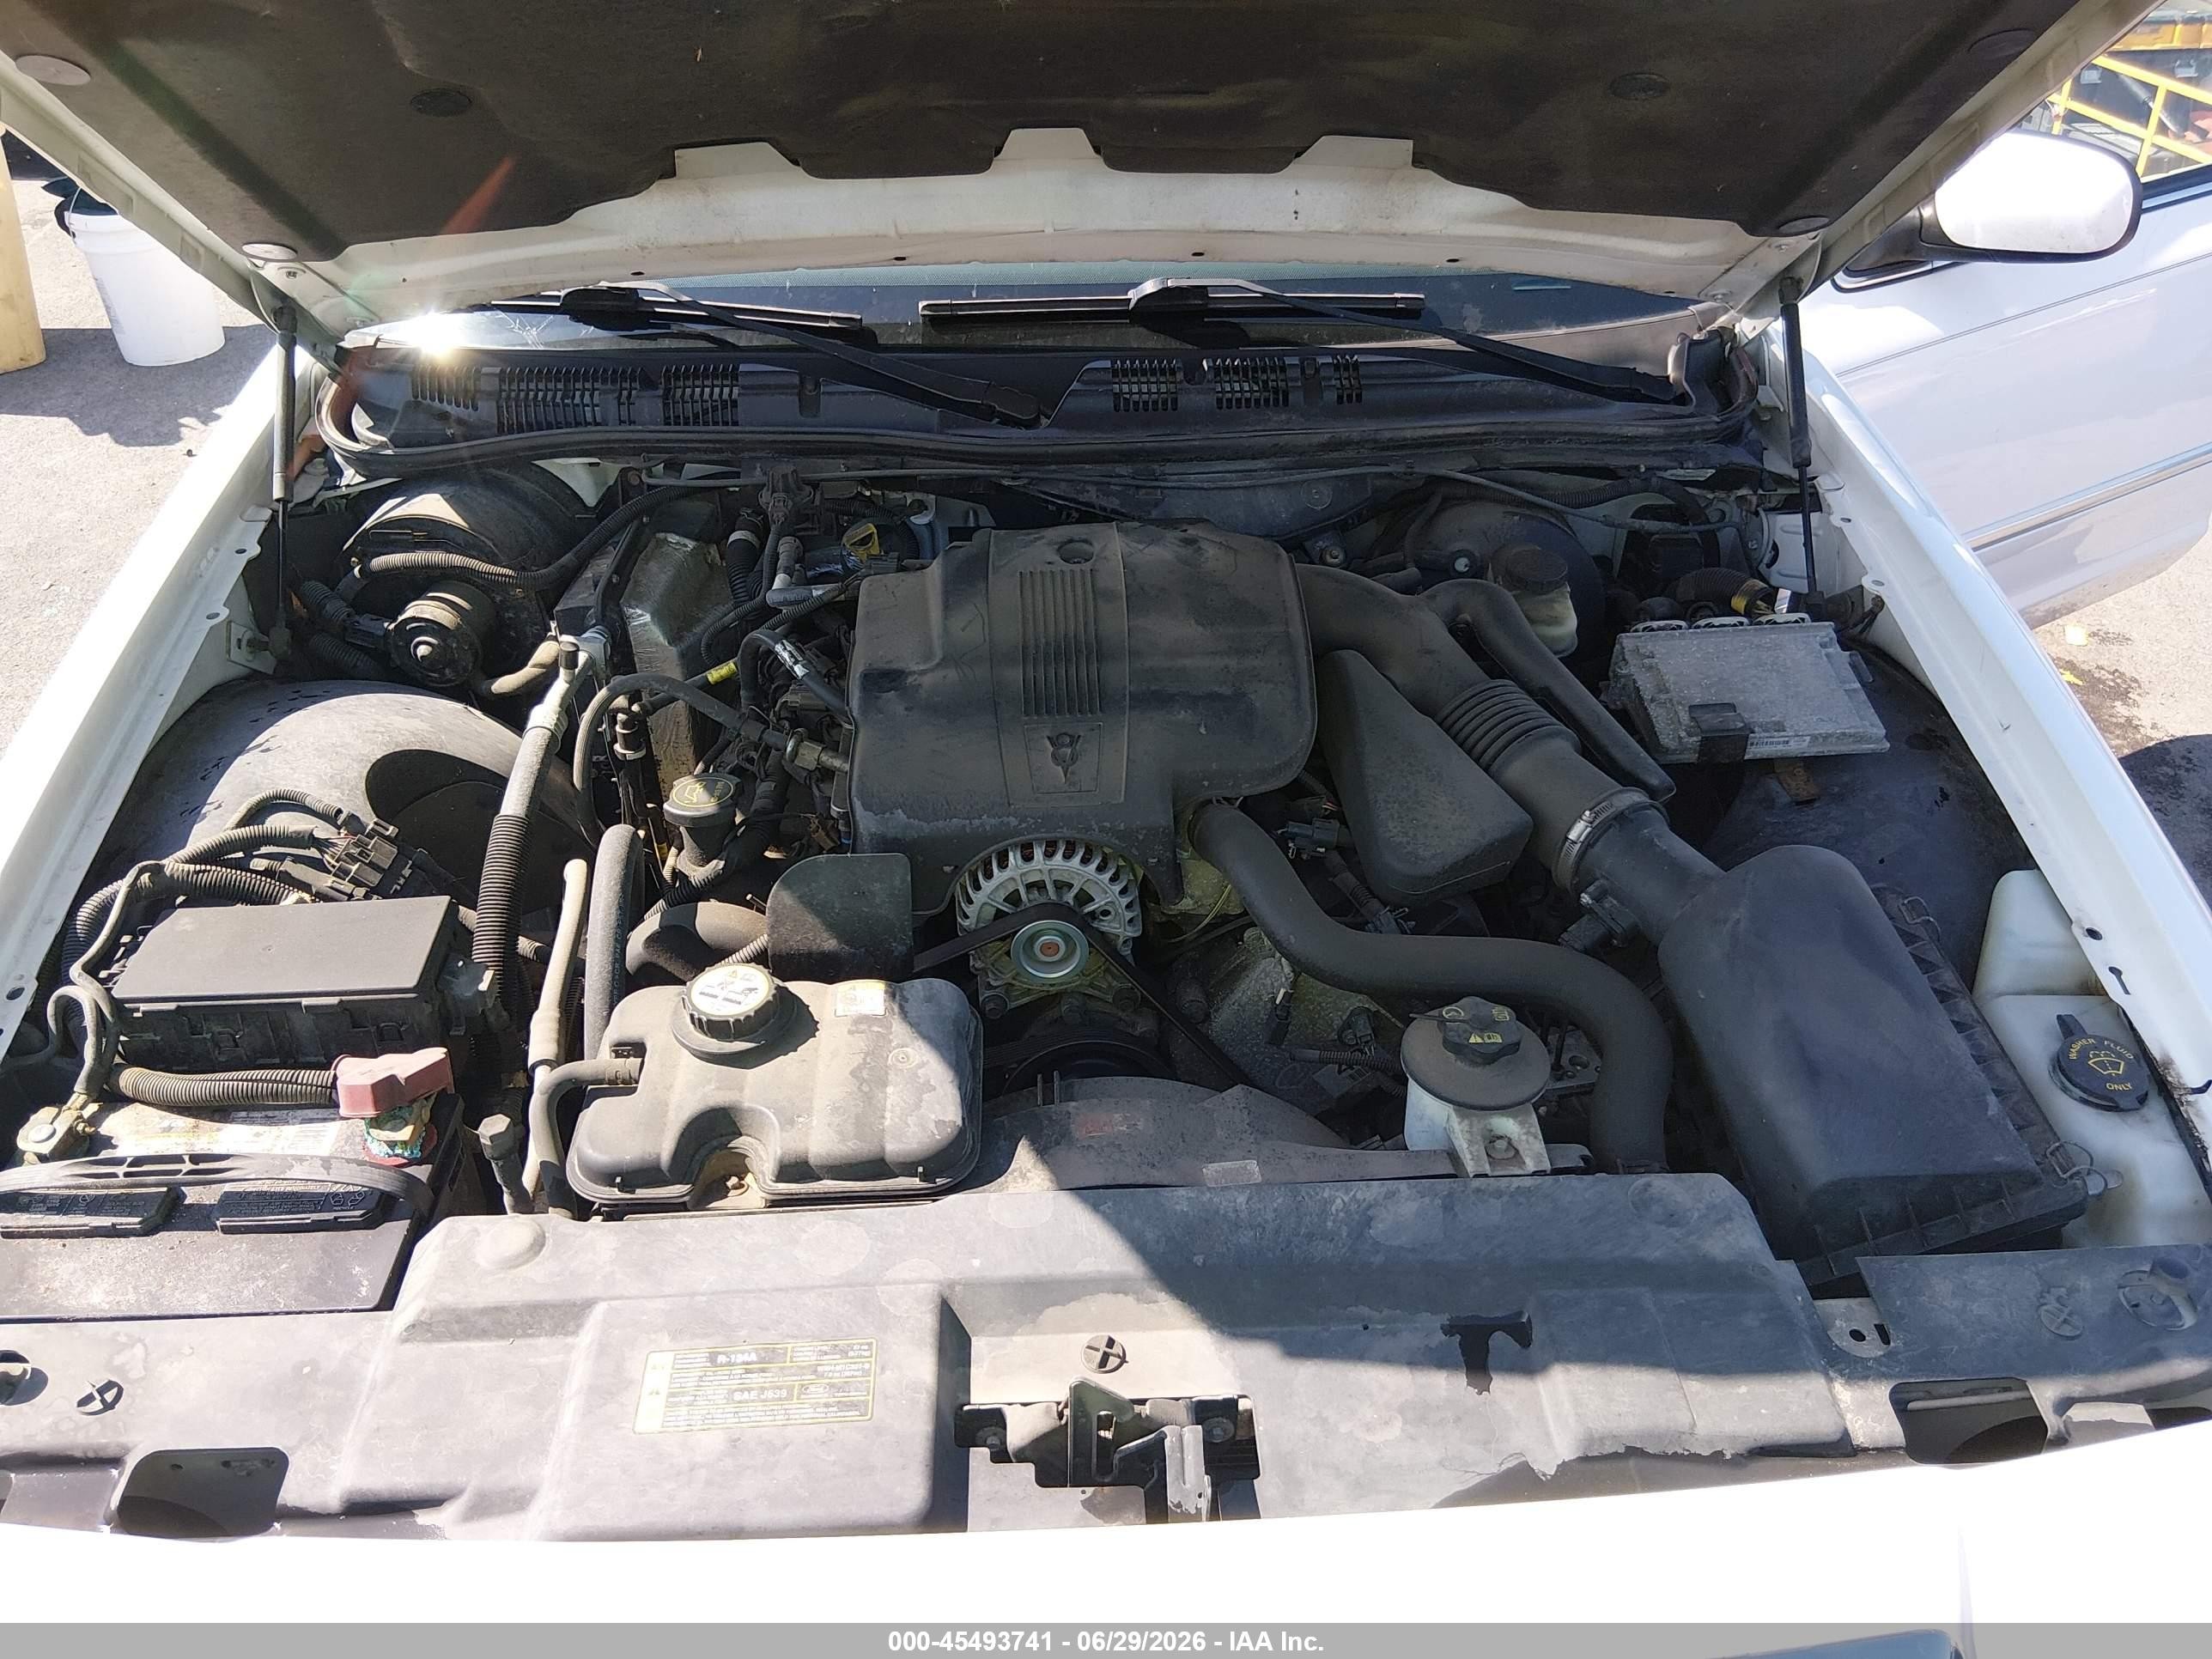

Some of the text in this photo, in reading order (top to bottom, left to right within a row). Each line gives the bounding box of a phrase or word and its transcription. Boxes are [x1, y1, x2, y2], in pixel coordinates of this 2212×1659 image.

[2068, 1037, 2135, 1060] WASHER FLUID
[2106, 1082, 2133, 1091] ONLY
[732, 1390, 759, 1401] SAE
[760, 1389, 787, 1400] J639
